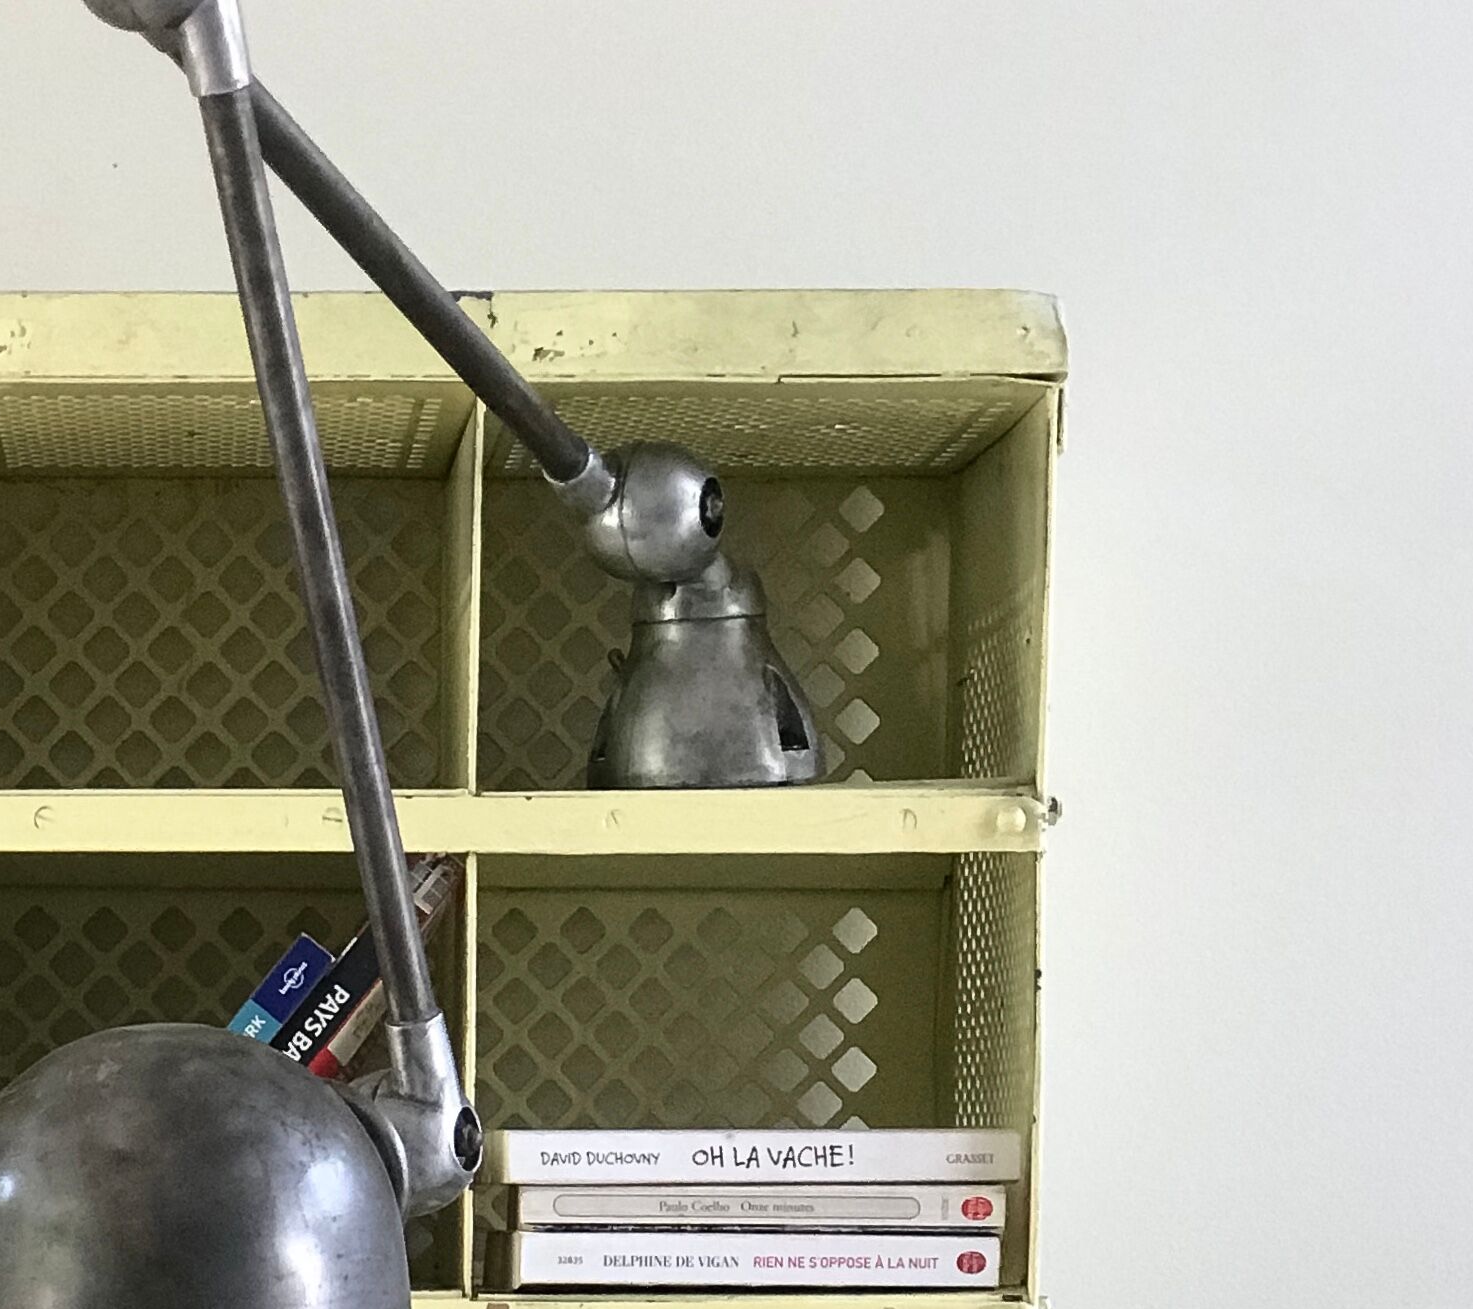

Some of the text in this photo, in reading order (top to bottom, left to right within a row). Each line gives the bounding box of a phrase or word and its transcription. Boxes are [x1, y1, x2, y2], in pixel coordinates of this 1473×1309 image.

[282, 985, 350, 1061] PAYS BA
[541, 1151, 582, 1166] DAVID
[586, 1151, 661, 1166] DUCHOVNY
[692, 1146, 725, 1168] OH
[733, 1146, 760, 1169] LA
[946, 1153, 995, 1165] GRASSET
[659, 1200, 730, 1212] Paulo Coelho
[603, 1255, 672, 1268] DELPHINE
[676, 1256, 695, 1268] DE
[697, 1256, 740, 1268] VIGAN
[753, 1257, 784, 1268] RIEN
[787, 1257, 805, 1268] NE
[808, 1257, 871, 1269] S'OPPOSE
[888, 1257, 905, 1269] LA
[908, 1257, 939, 1269] NUIT
